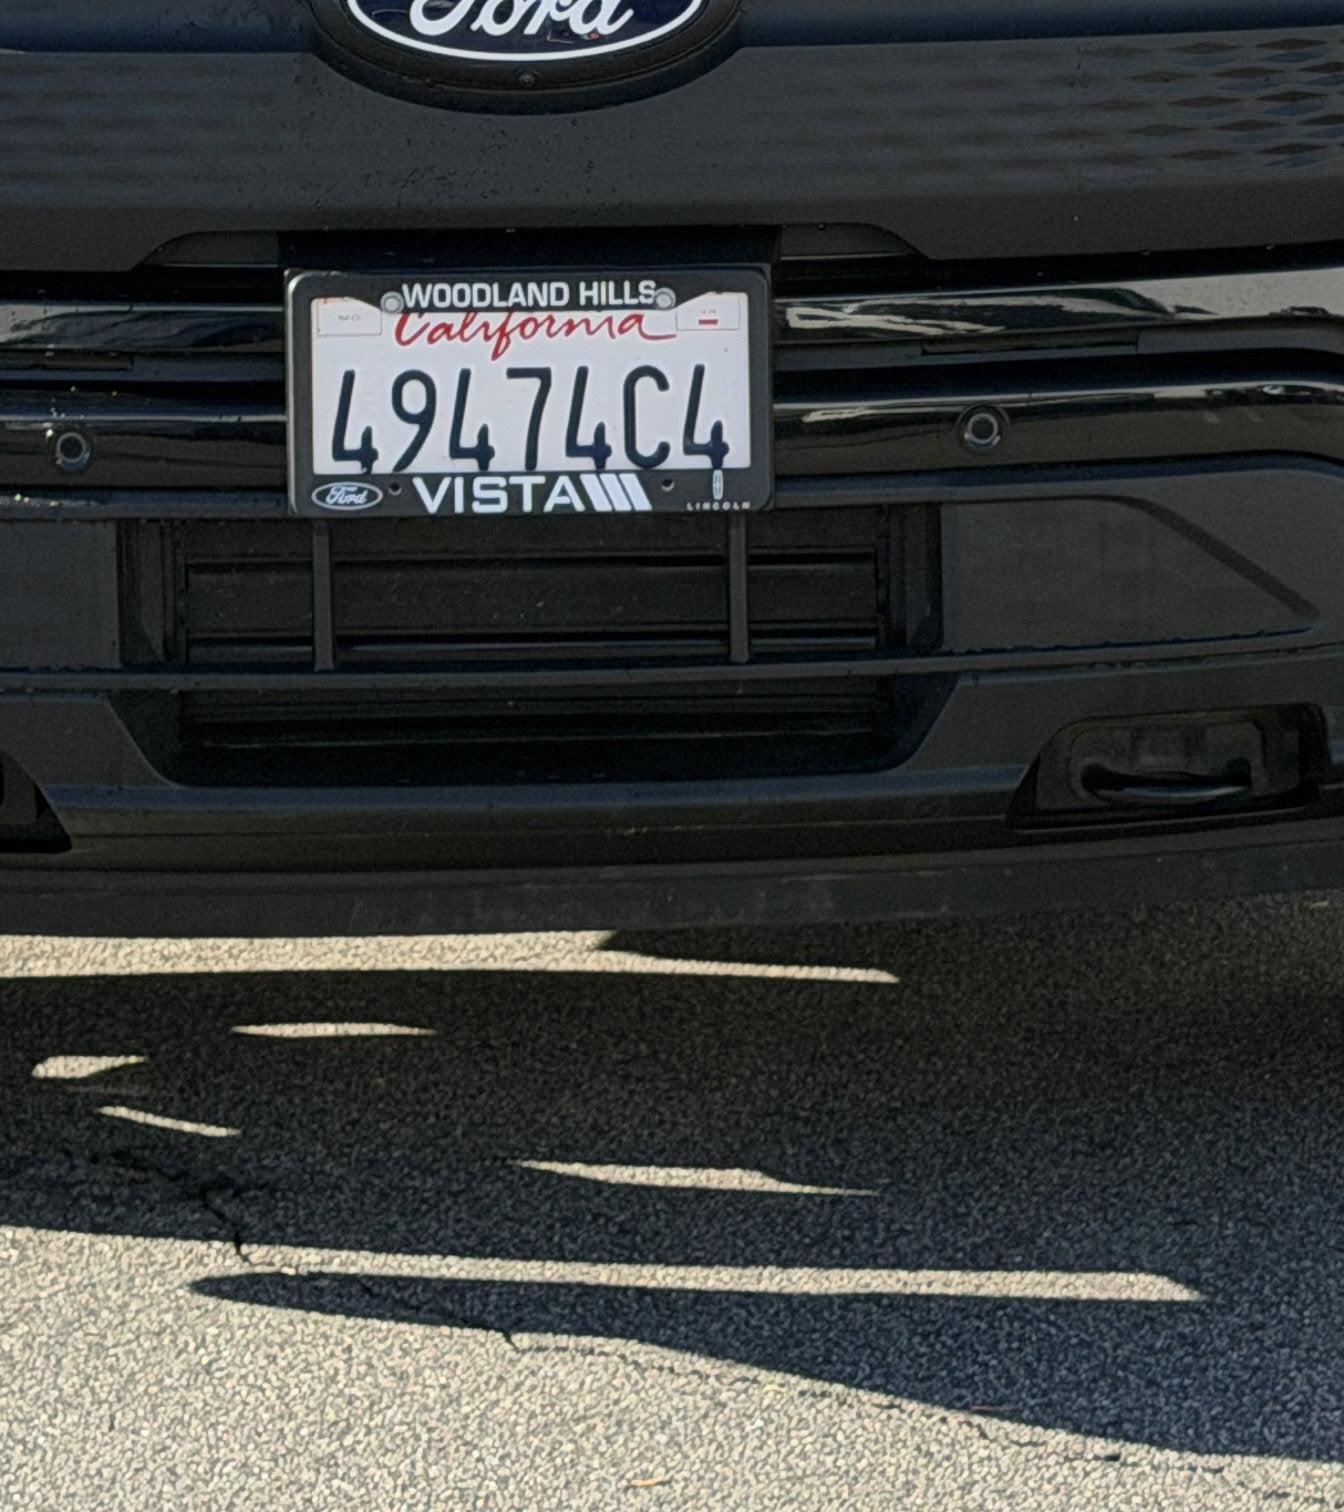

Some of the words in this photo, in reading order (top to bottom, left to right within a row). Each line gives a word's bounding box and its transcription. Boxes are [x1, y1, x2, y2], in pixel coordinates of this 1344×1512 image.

[402, 281, 570, 309] WOODLAND
[579, 280, 656, 307] HILLS
[394, 310, 677, 361] California
[331, 363, 729, 473] 49474C4
[325, 485, 369, 505] Ford
[412, 474, 585, 513] VISTA
